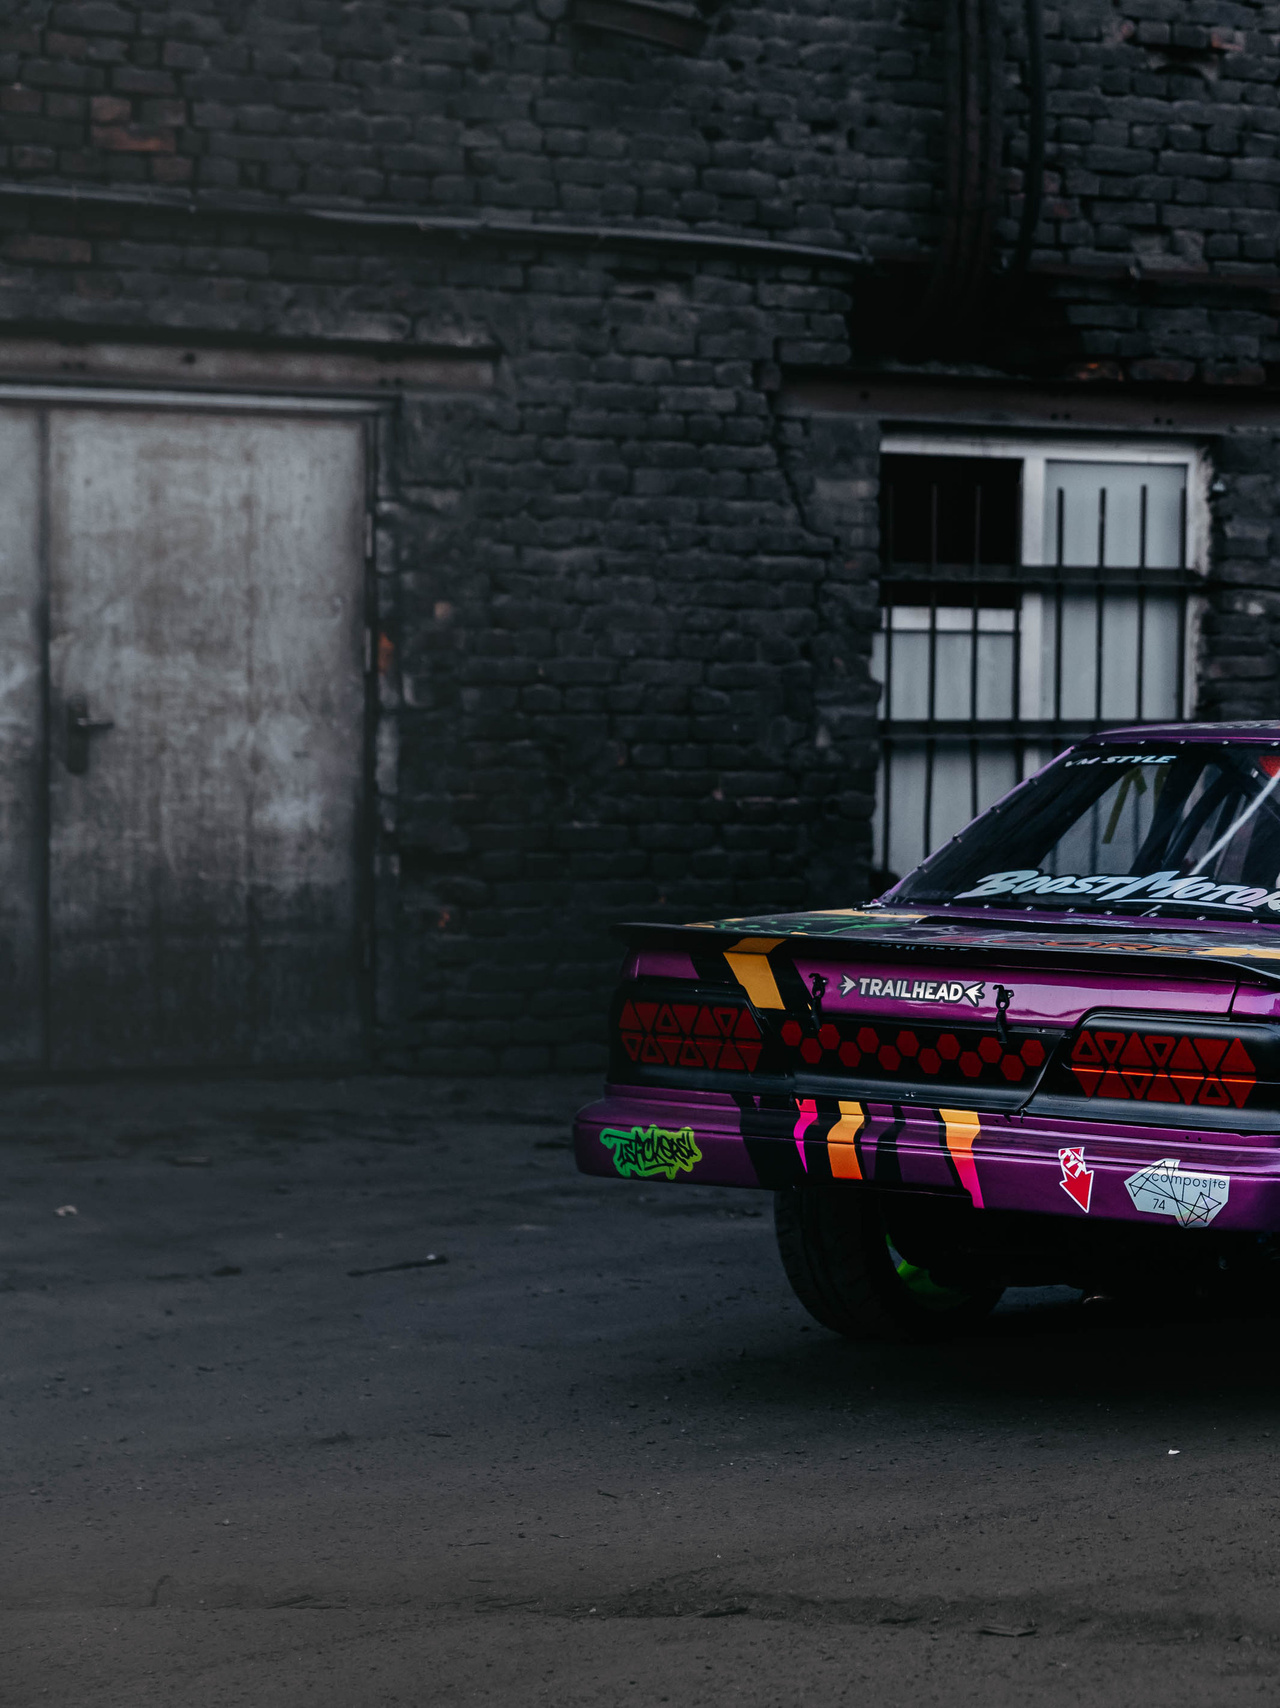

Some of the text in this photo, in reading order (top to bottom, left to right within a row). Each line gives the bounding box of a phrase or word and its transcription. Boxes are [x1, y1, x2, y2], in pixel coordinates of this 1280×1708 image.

[1101, 755, 1178, 764] STYLE
[859, 977, 964, 1001] TRAILHEAD
[1151, 1173, 1227, 1190] composite
[1153, 1198, 1166, 1210] 74
